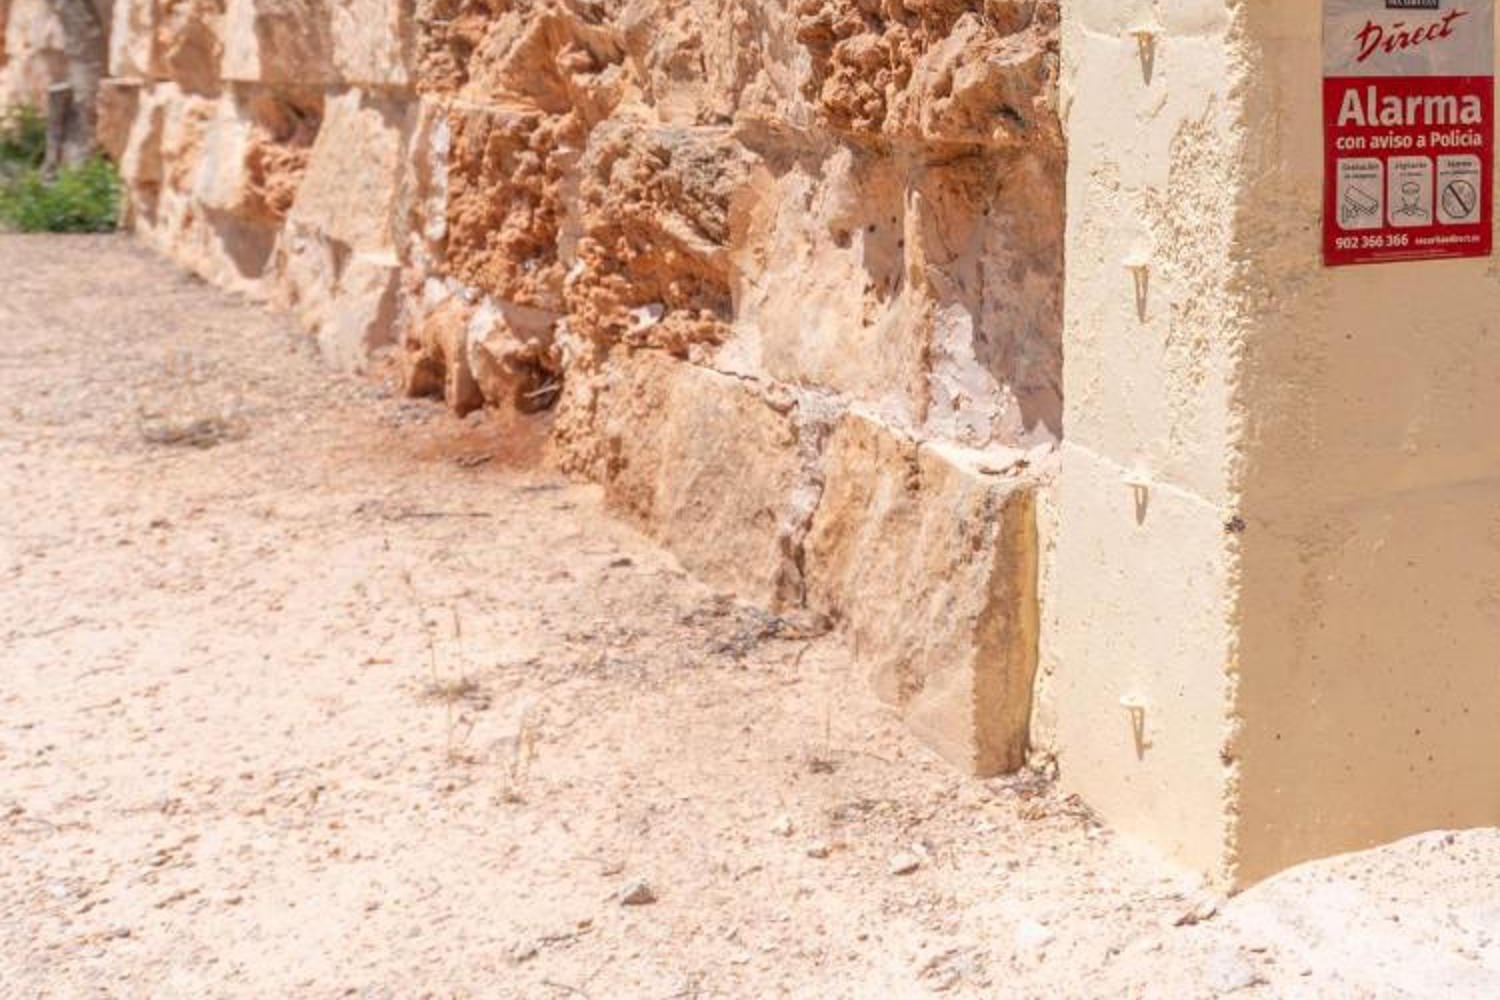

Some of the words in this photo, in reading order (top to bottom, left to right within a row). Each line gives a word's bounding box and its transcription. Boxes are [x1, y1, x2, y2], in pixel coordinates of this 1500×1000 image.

[1354, 8, 1470, 63] Direct
[1337, 85, 1482, 127] Alarma
[1336, 135, 1365, 149] con
[1370, 130, 1413, 149] aviso
[1416, 135, 1426, 148] a
[1335, 236, 1359, 249] 902
[1386, 233, 1409, 247] 366
